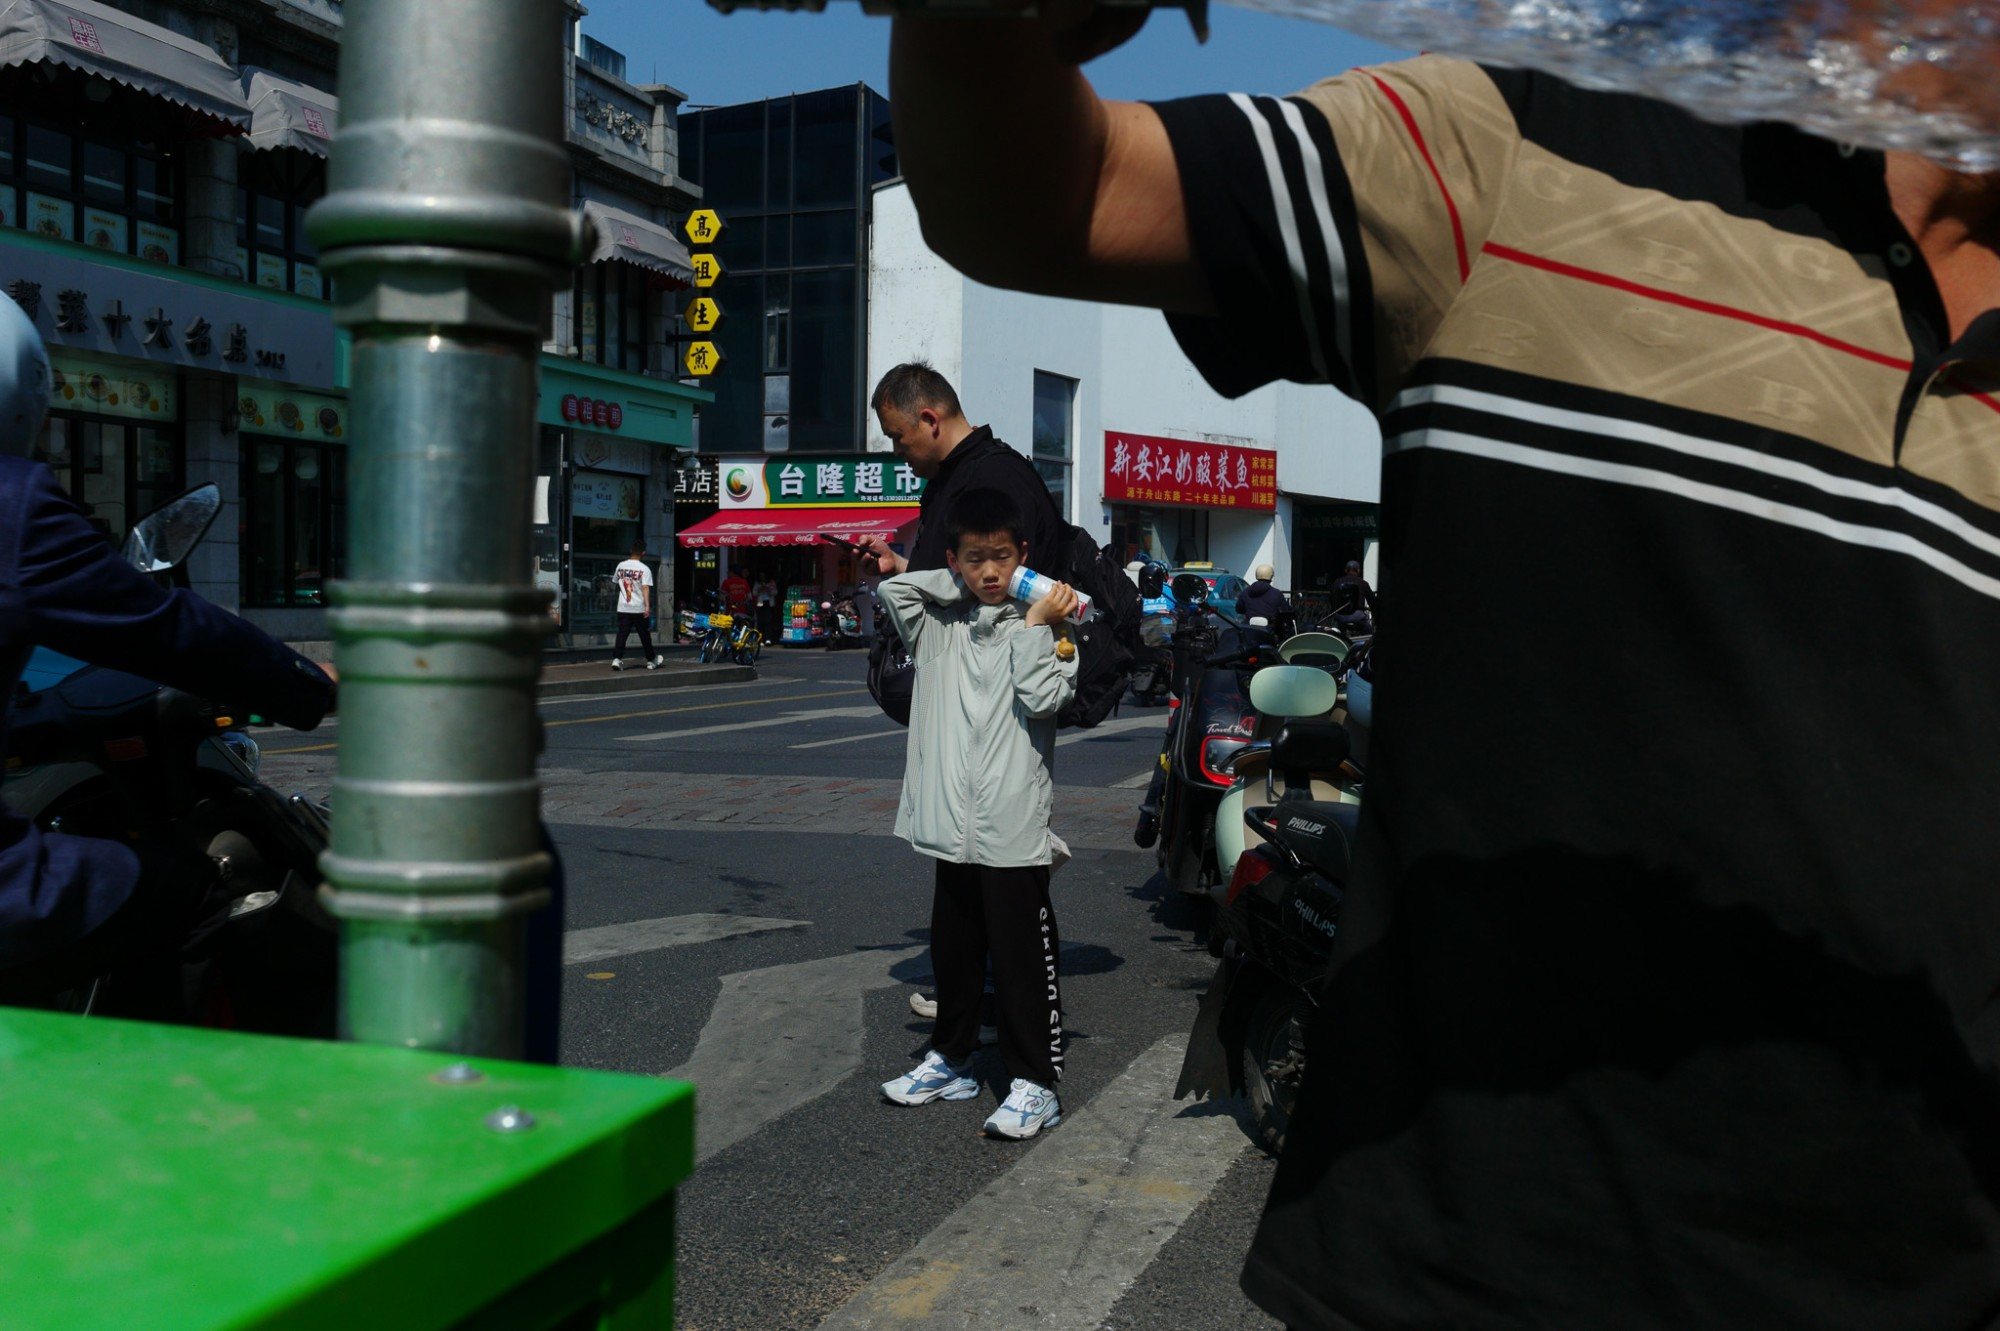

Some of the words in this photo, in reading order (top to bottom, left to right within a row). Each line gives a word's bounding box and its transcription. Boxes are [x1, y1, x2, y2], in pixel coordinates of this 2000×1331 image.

[691, 215, 712, 370] 高祖生煎
[779, 462, 921, 496] 台隆超市
[1287, 816, 1327, 835] PHILLIPS
[1294, 898, 1336, 938] PHILLIPS
